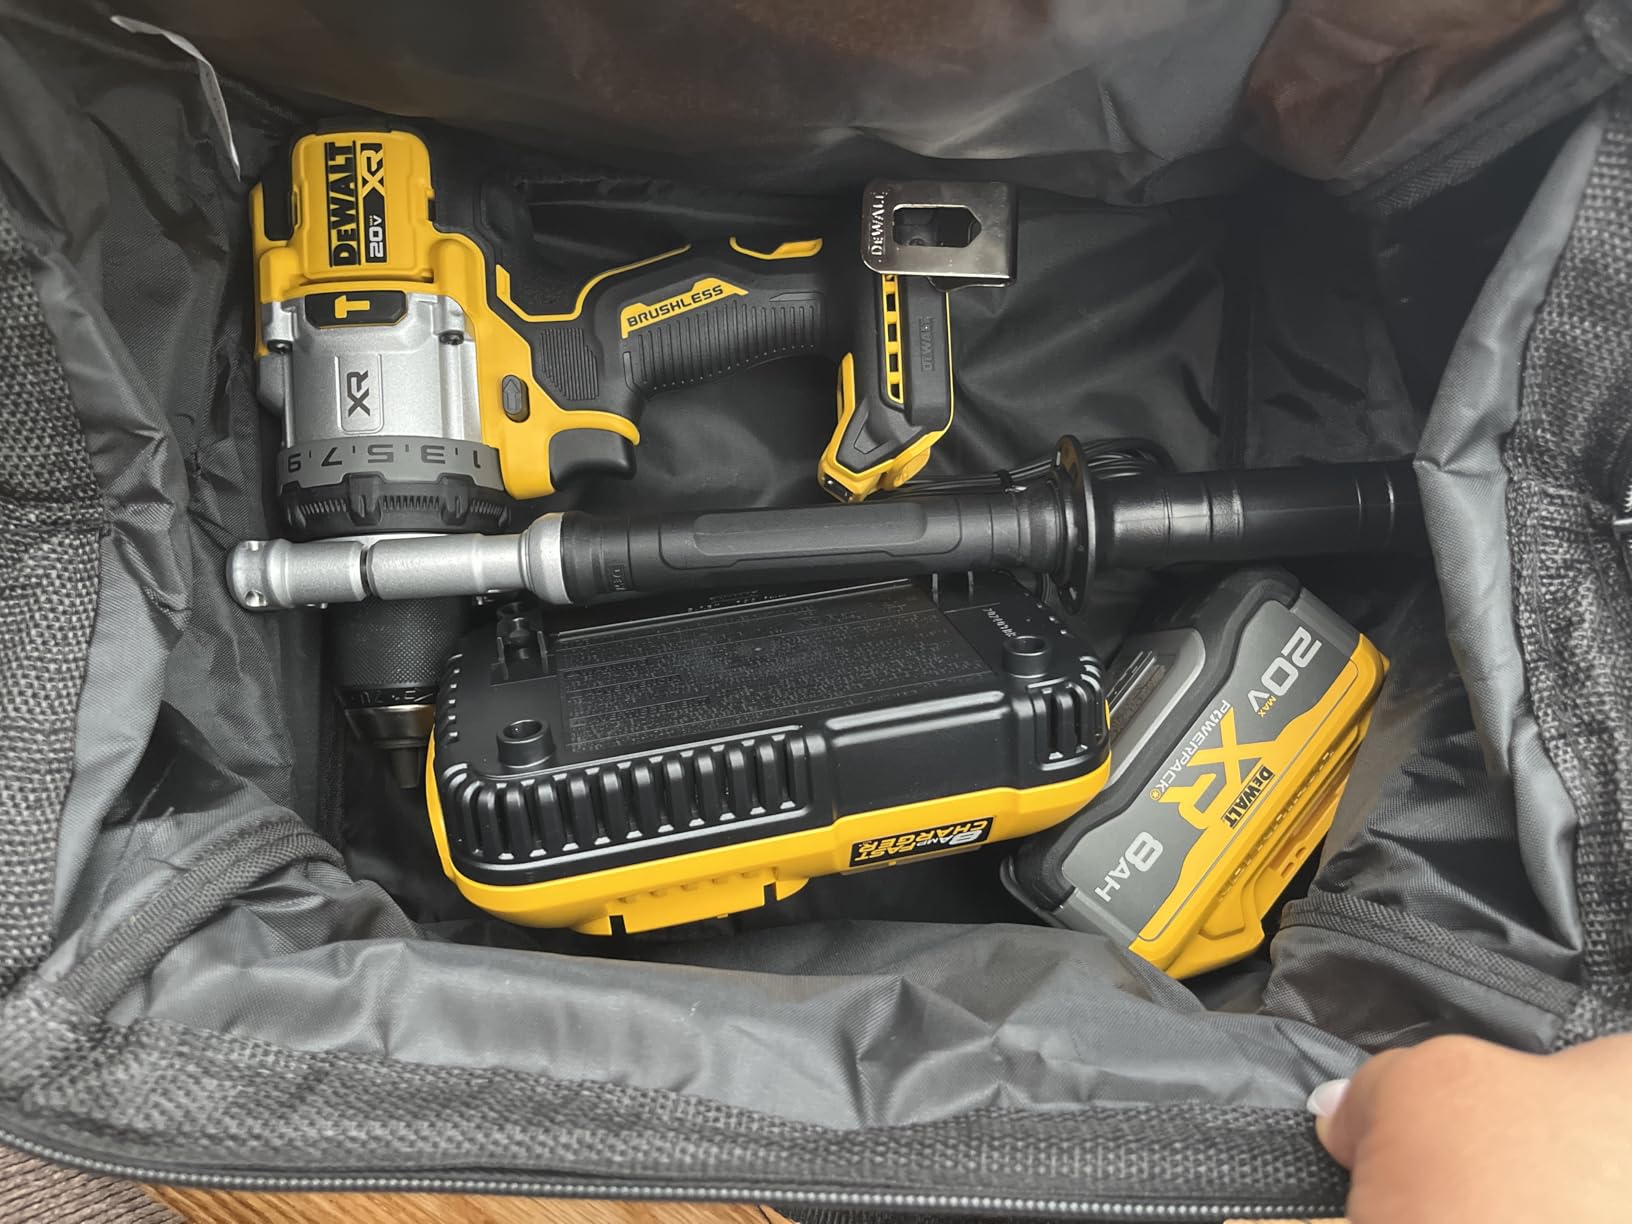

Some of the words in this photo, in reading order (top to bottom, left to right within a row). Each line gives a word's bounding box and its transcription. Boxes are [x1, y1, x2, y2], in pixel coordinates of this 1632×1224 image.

[361, 149, 387, 199] XR
[327, 142, 359, 266] DEWALT
[369, 215, 384, 258] 20V
[626, 284, 725, 328] BRUSHLESS
[346, 370, 371, 418] XR
[287, 453, 302, 473] 9
[321, 447, 343, 467] 7
[367, 444, 394, 464] 5
[420, 445, 446, 465] 3
[473, 450, 481, 469] 1
[1247, 626, 1322, 712] 20V
[1257, 695, 1277, 717] MAX
[1157, 699, 1233, 793] POWERPACK
[1158, 707, 1273, 830] XR
[1222, 766, 1275, 828] DEWALT
[854, 841, 916, 861] FAST
[859, 820, 988, 853] CHARGER
